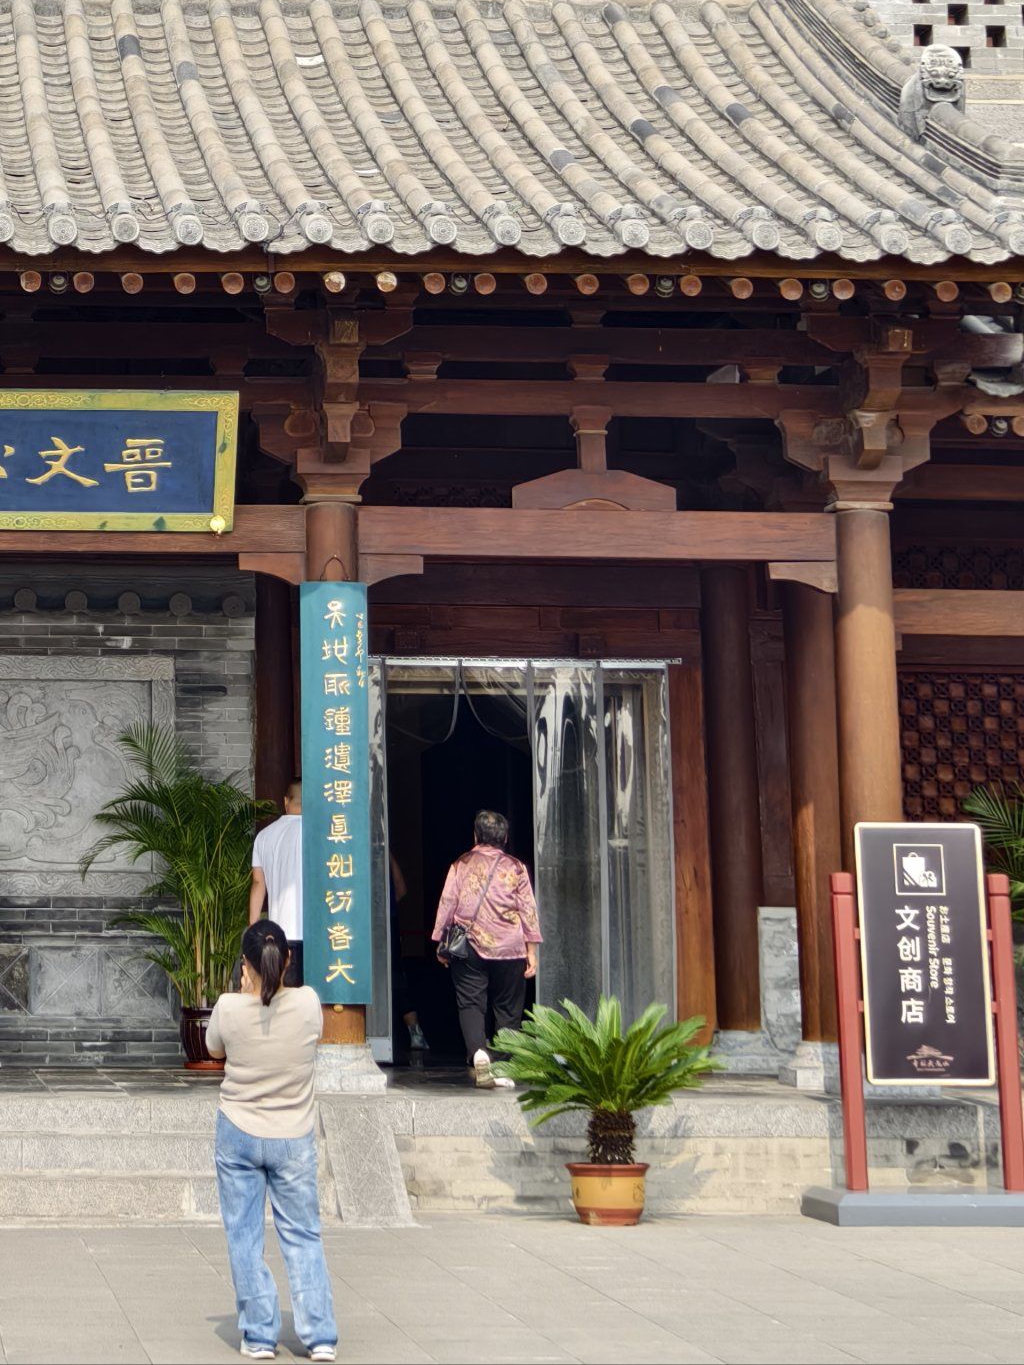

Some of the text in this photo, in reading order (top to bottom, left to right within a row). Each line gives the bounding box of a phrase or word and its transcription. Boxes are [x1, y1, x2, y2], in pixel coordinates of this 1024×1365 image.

[895, 906, 924, 1024] 文创商店
[925, 905, 939, 990] Souvenir Store
